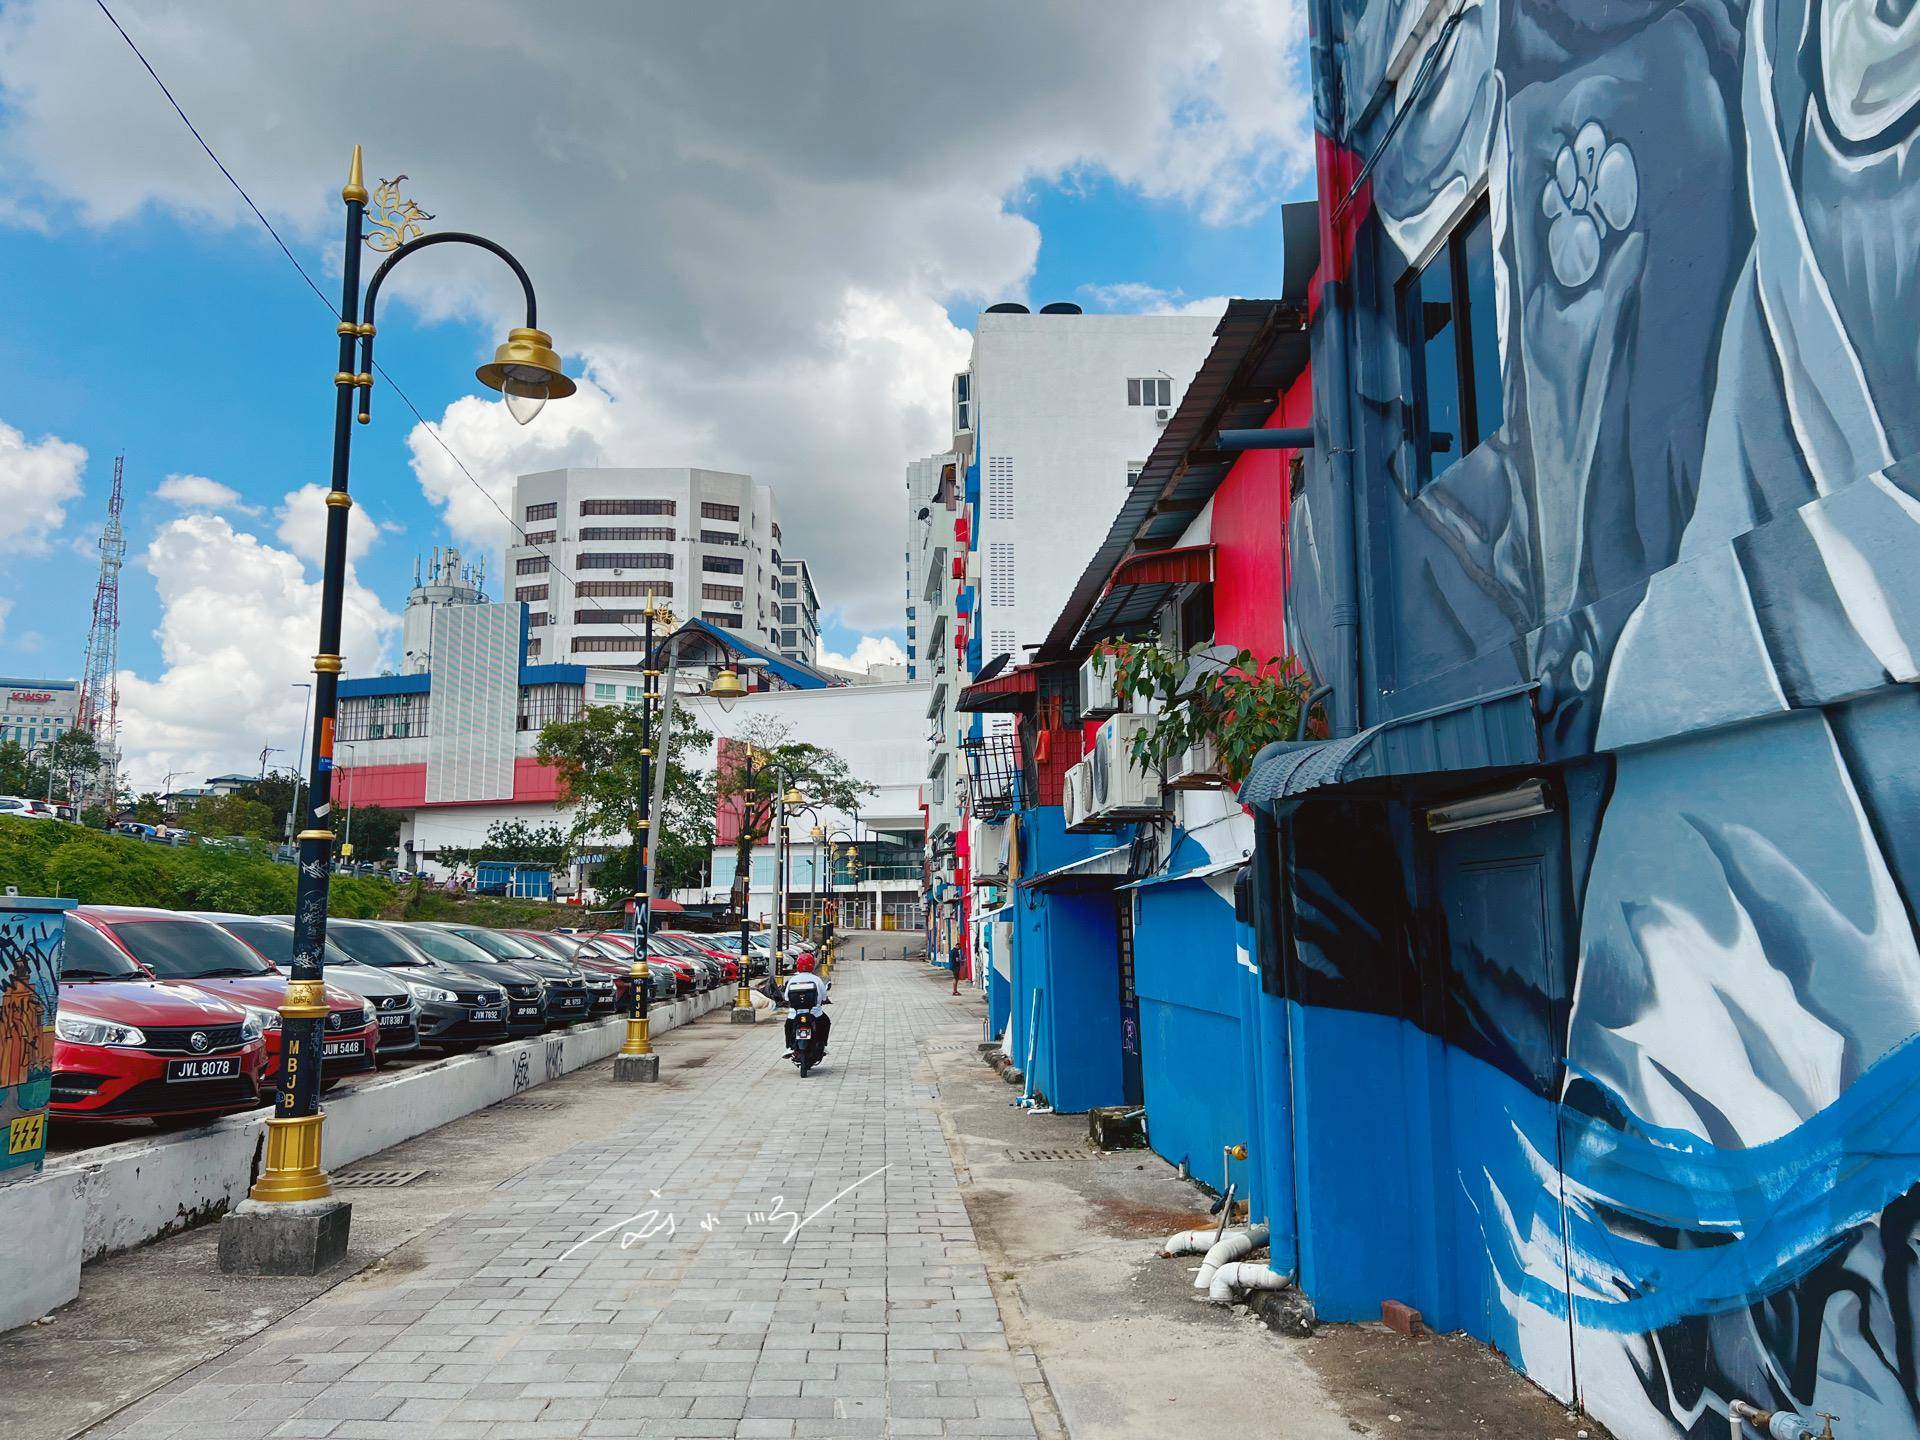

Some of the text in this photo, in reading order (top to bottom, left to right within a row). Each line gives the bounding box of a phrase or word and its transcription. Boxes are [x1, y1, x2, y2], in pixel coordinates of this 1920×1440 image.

[12, 692, 51, 703] KWSP
[339, 1041, 360, 1054] 5448
[178, 1060, 230, 1077] JVL 8078
[284, 1040, 300, 1108] MBJB
